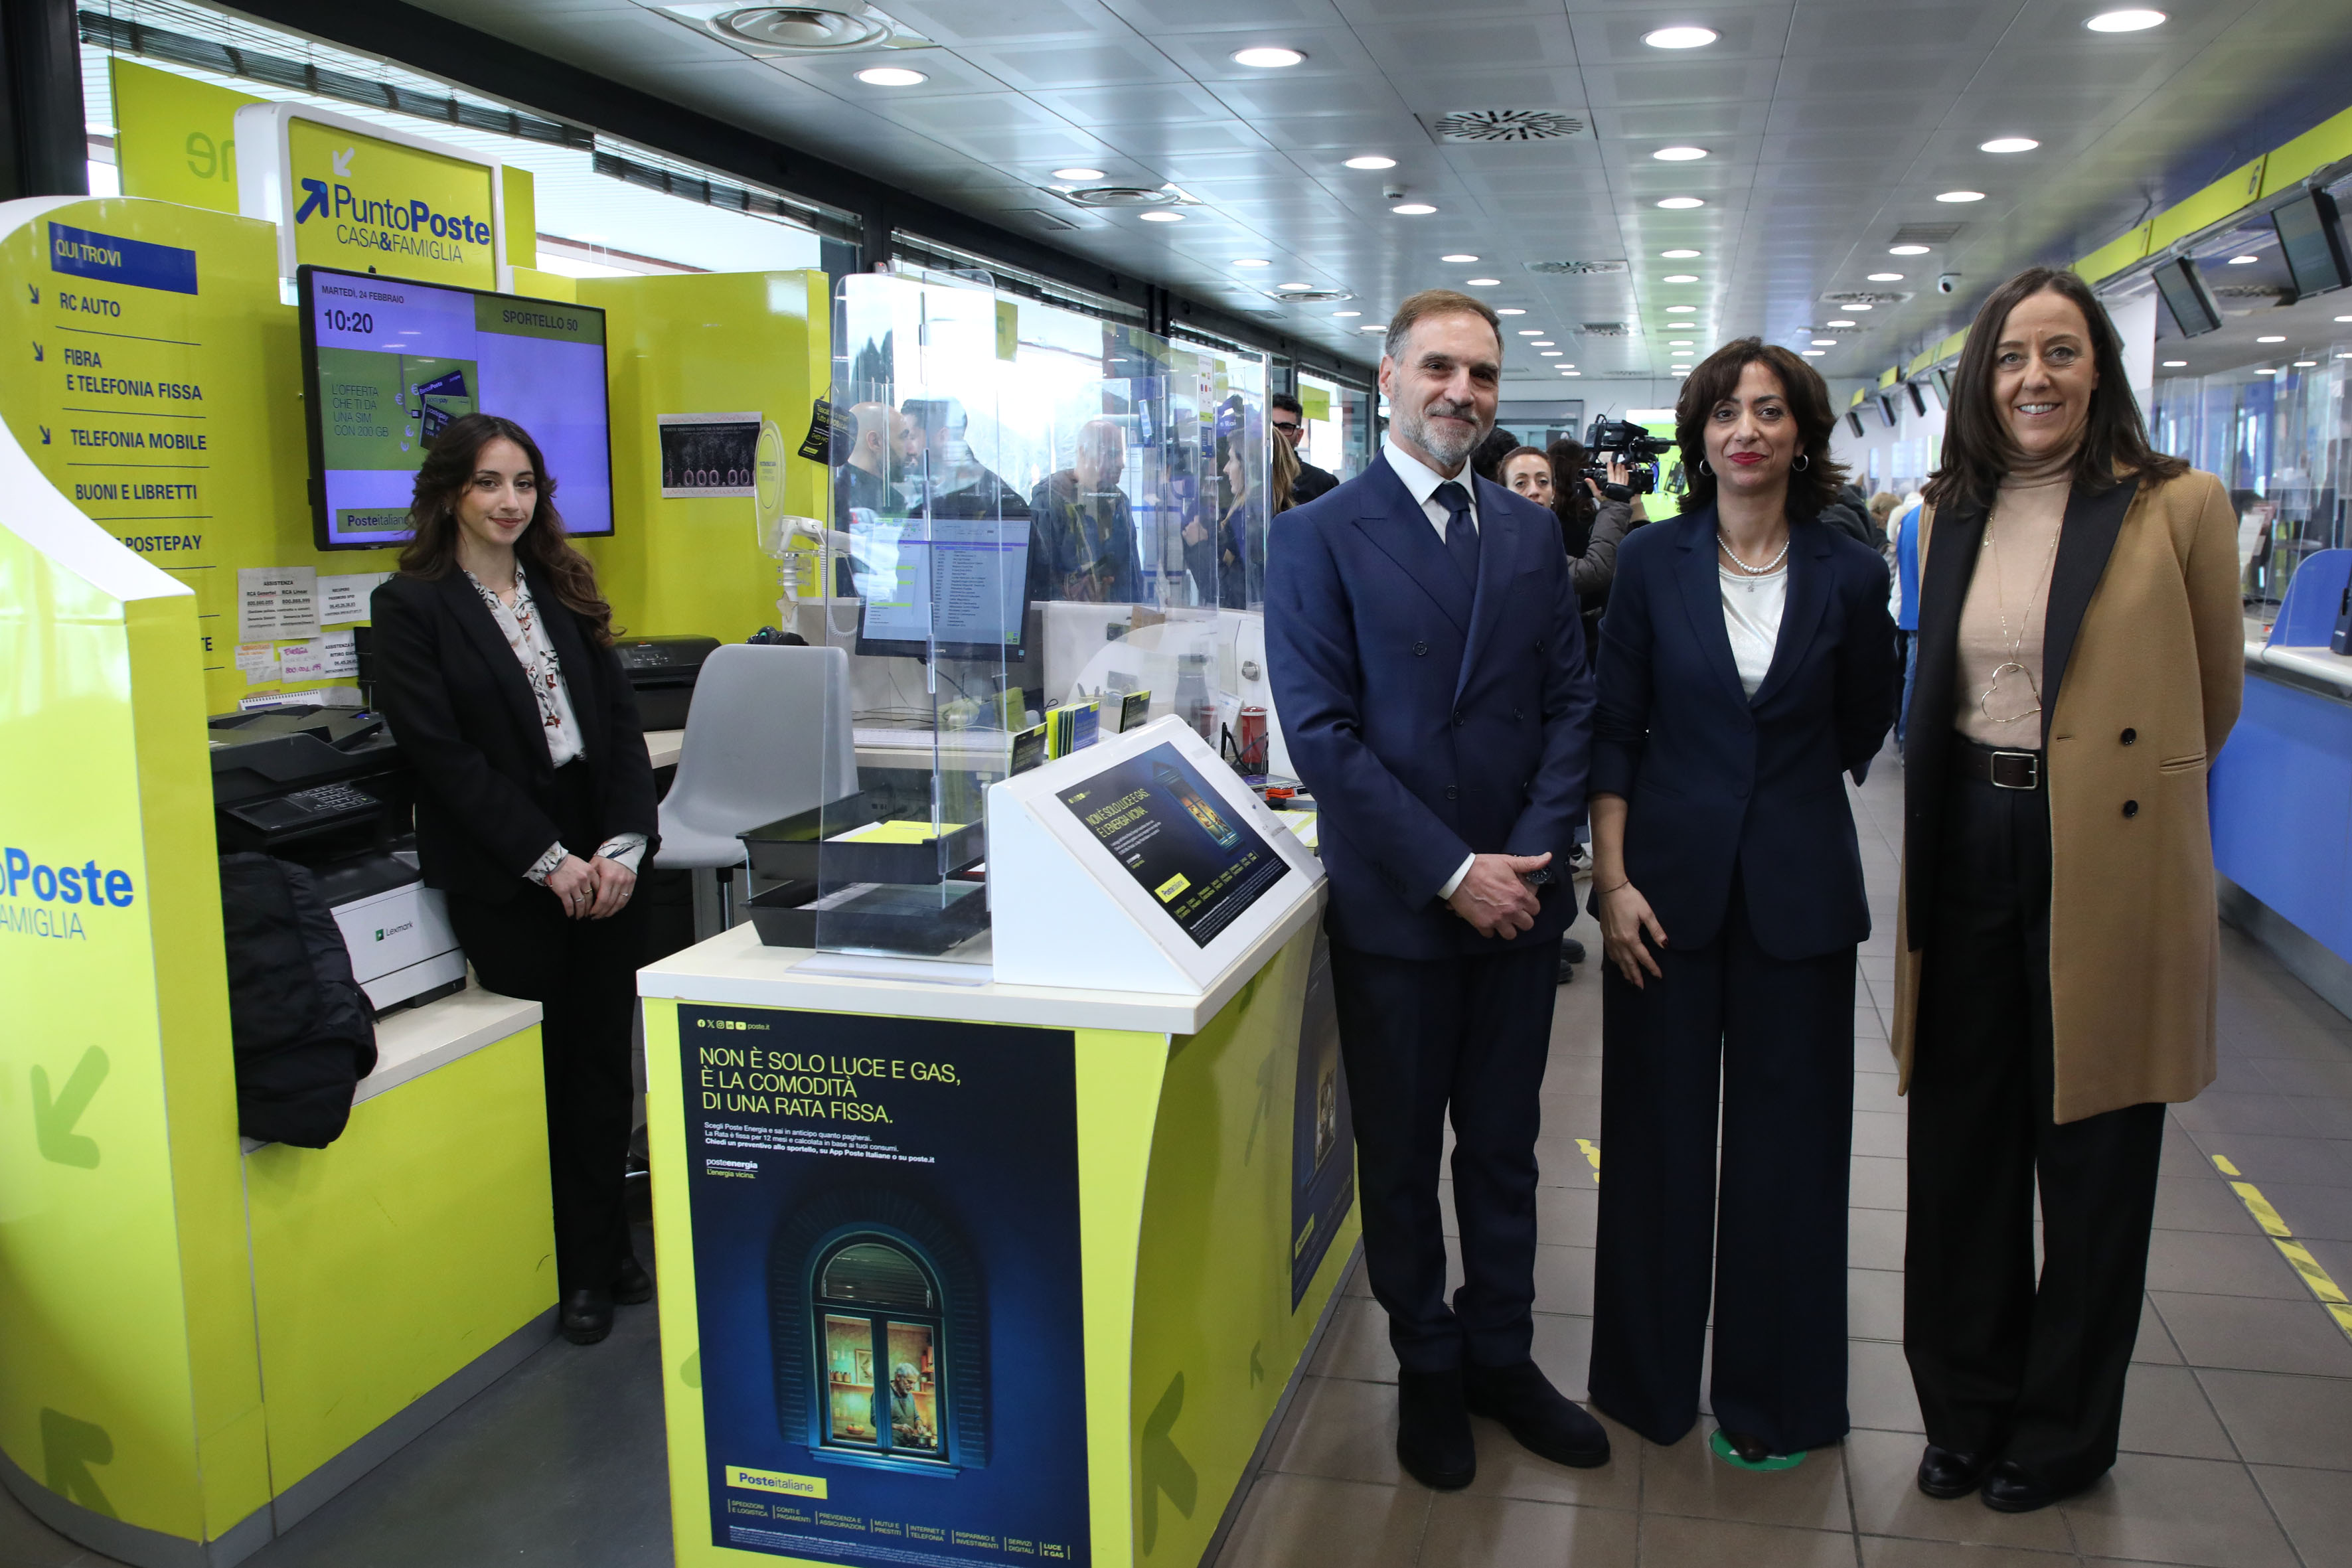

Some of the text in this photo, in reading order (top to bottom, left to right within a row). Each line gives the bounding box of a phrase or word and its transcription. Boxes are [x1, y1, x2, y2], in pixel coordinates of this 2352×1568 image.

[334, 183, 490, 246] PuntoPoste
[337, 224, 463, 263] CASA&FAMIGLIA
[56, 239, 121, 268] QUI TROVI
[321, 285, 404, 303] MARTEDÌ, 24 FEBBRAIO
[60, 292, 121, 317] RC AUTO
[324, 309, 373, 334] 10:20
[503, 309, 578, 331] SPORTELLO 50
[64, 349, 102, 368] FIBRA
[66, 374, 202, 401] E TELEFONIA FISSA
[332, 384, 378, 396] L'OFFERTA
[333, 398, 377, 410] CHE TI DA
[333, 412, 372, 423] UNA SIM
[334, 425, 388, 437] CON 200 GB
[70, 429, 206, 450] TELEFONIA MOBILE
[665, 469, 755, 487] 1.000.00
[76, 483, 197, 501] BUONI E LIBRETTI
[126, 535, 202, 552] POSTEPAY
[386, 920, 413, 936] Lexmark
[700, 1046, 961, 1086] NON È SOLO LUCE E GAS,
[701, 1065, 858, 1098] È LA COMODITÀ
[702, 1091, 893, 1123] DI UNA RATA FISSA.
[738, 1140, 771, 1149] preventivo
[787, 1145, 819, 1154] sportello,
[829, 1148, 843, 1156] App
[706, 1158, 757, 1169] posteenergia
[707, 1168, 734, 1178] L'energia
[739, 1472, 814, 1492] Posteitaliane
[732, 1500, 765, 1510] SPEDIZIONI
[737, 1508, 768, 1517] LOGISTICA
[776, 1513, 811, 1523] PAGAMENTI
[819, 1512, 856, 1523] PREVIDENZA
[819, 1520, 866, 1530] ASSICURAZIONI
[910, 1526, 940, 1535] INTERNET
[911, 1532, 944, 1541] TELEFONIA
[955, 1531, 990, 1541] RISPARMIO
[956, 1539, 998, 1549] INVESTIMENTI
[1008, 1545, 1034, 1554] DIGITALI
